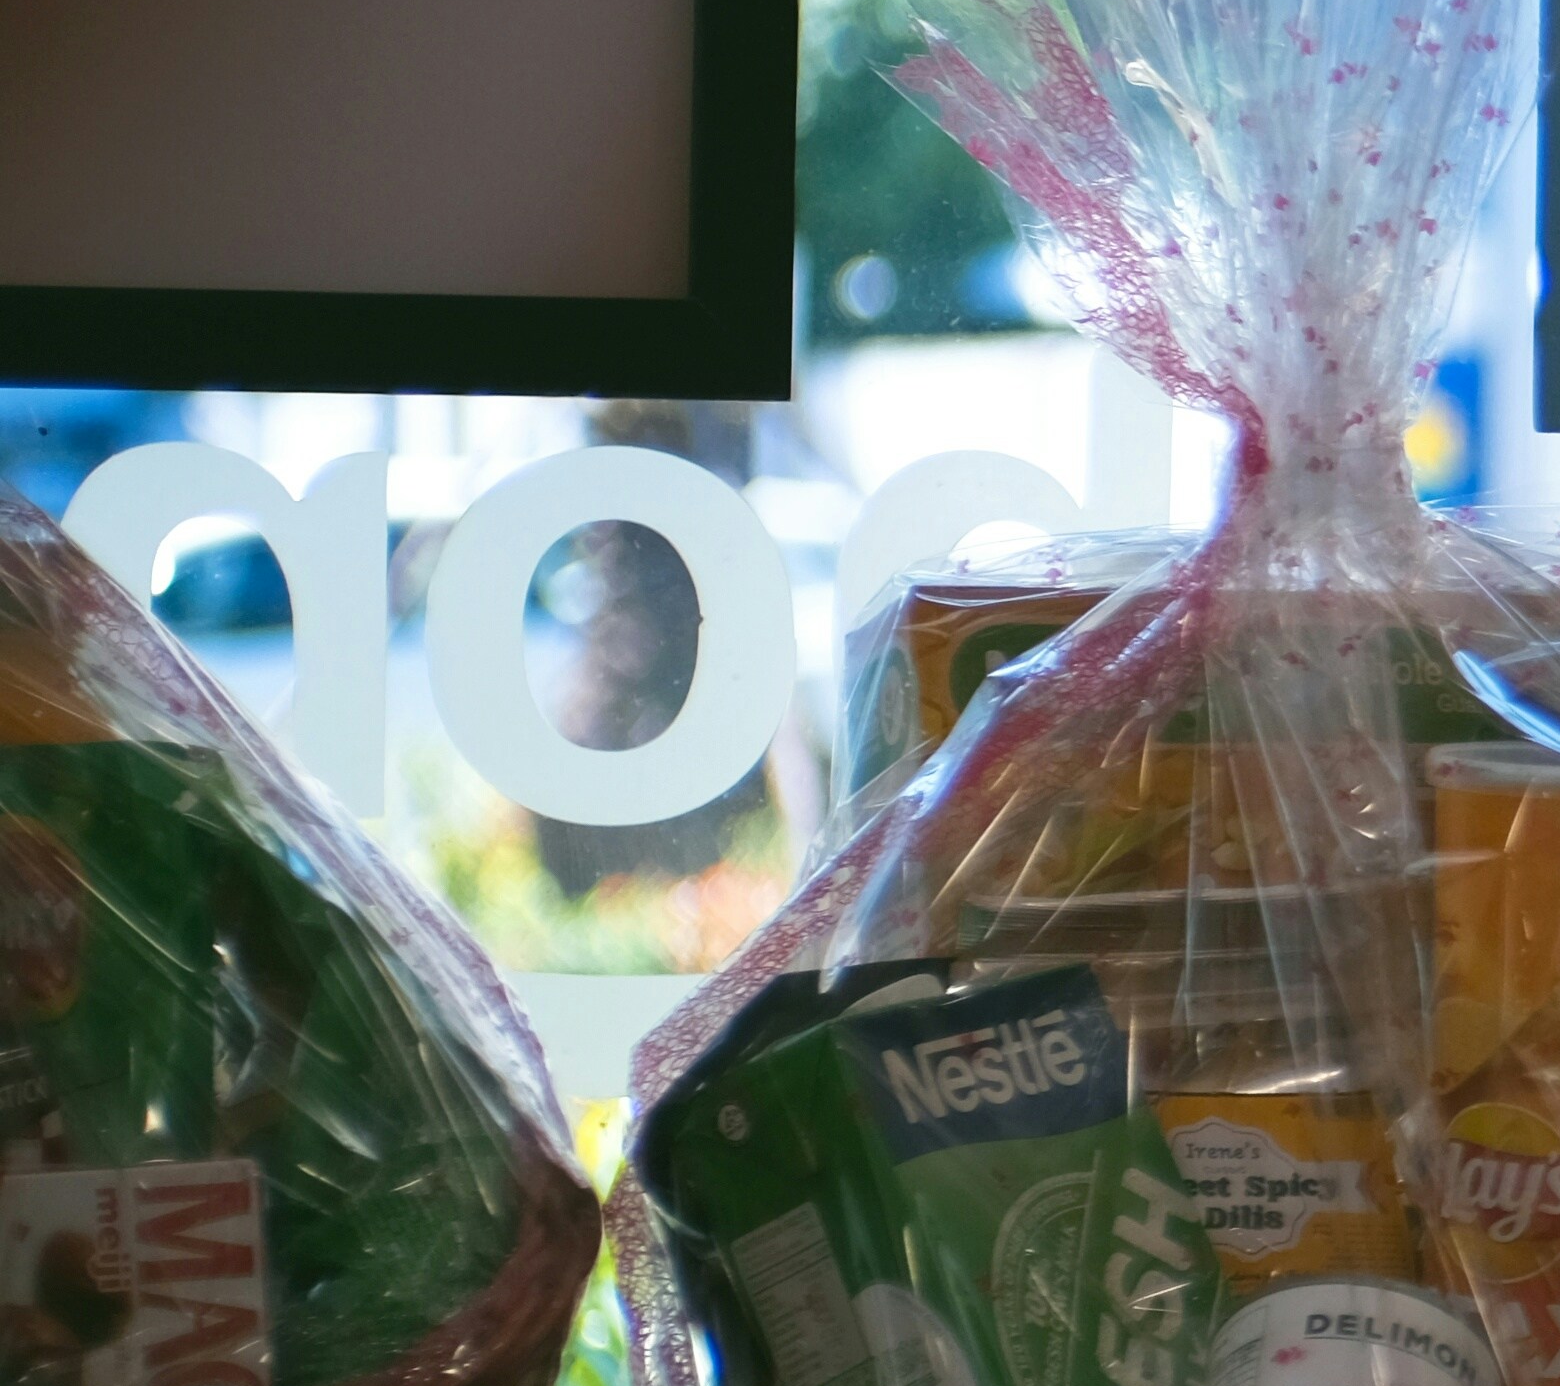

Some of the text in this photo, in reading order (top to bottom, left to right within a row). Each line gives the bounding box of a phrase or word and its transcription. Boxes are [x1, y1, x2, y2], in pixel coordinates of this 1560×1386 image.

[1185, 1142, 1261, 1160] Irene's
[1180, 1177, 1231, 1198] eet
[1204, 1204, 1285, 1231] Dilis
[87, 1186, 132, 1295] meiji
